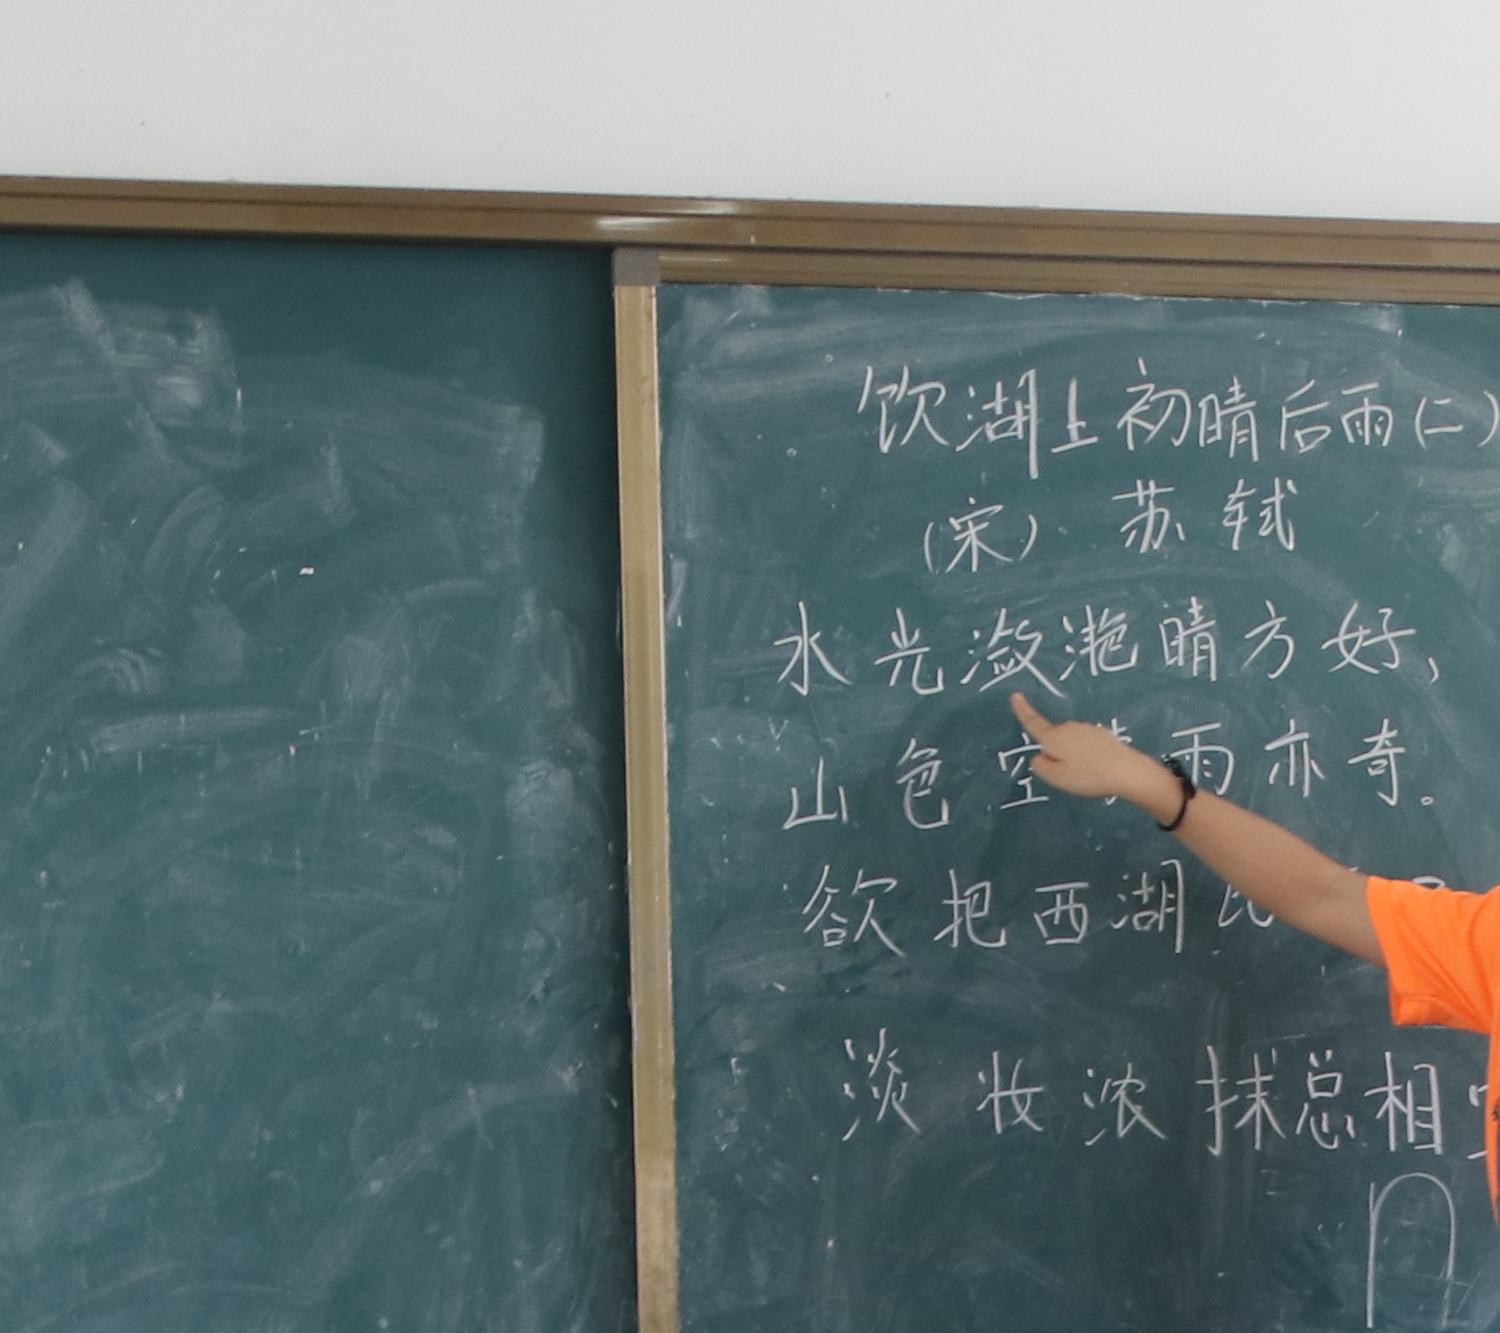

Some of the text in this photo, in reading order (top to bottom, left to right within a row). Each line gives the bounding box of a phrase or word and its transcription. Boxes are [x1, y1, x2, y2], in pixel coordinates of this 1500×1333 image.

[1111, 477, 1299, 553] 苏轼
[781, 717, 1437, 832] 山色空雨亦奇。
[840, 1026, 1490, 1161] 淡妆浓抹总相
